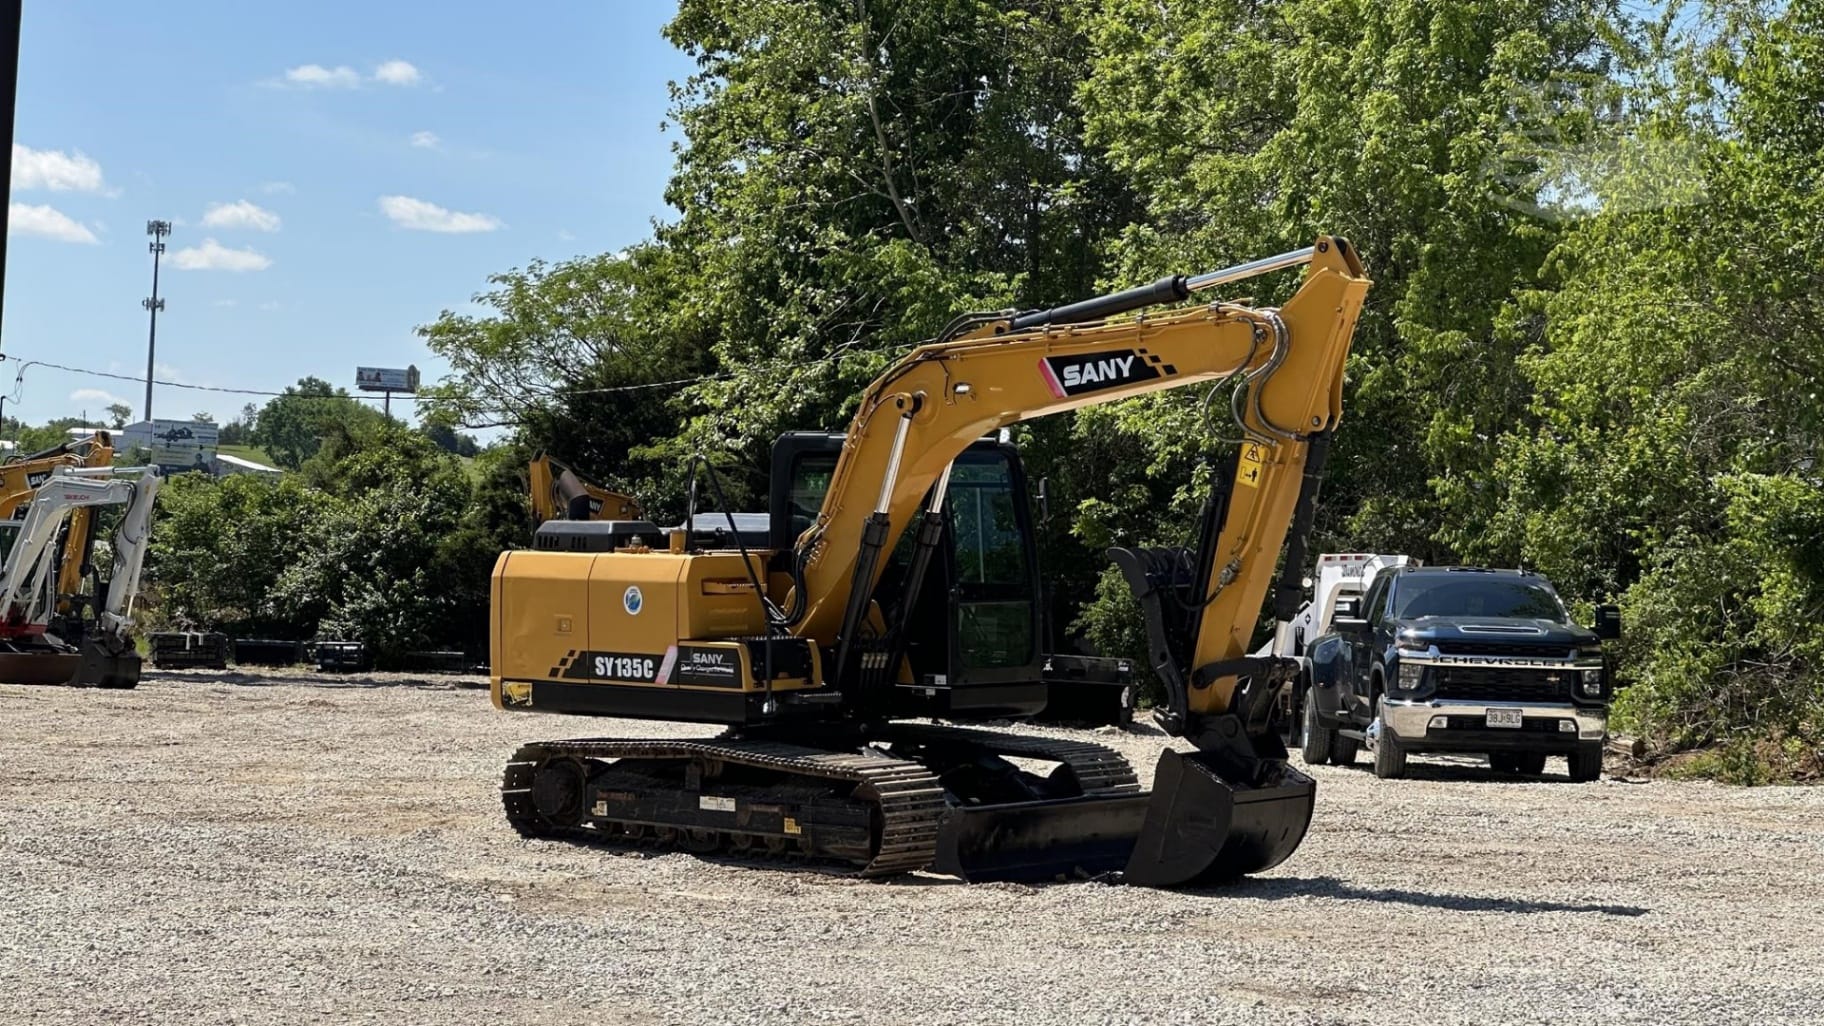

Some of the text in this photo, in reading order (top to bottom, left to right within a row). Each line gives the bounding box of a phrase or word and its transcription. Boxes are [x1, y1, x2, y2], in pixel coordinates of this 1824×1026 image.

[1063, 355, 1135, 387] SANY
[693, 653, 724, 664] SANY
[1440, 656, 1567, 667] CHEVROLET
[595, 656, 654, 679] SY135C
